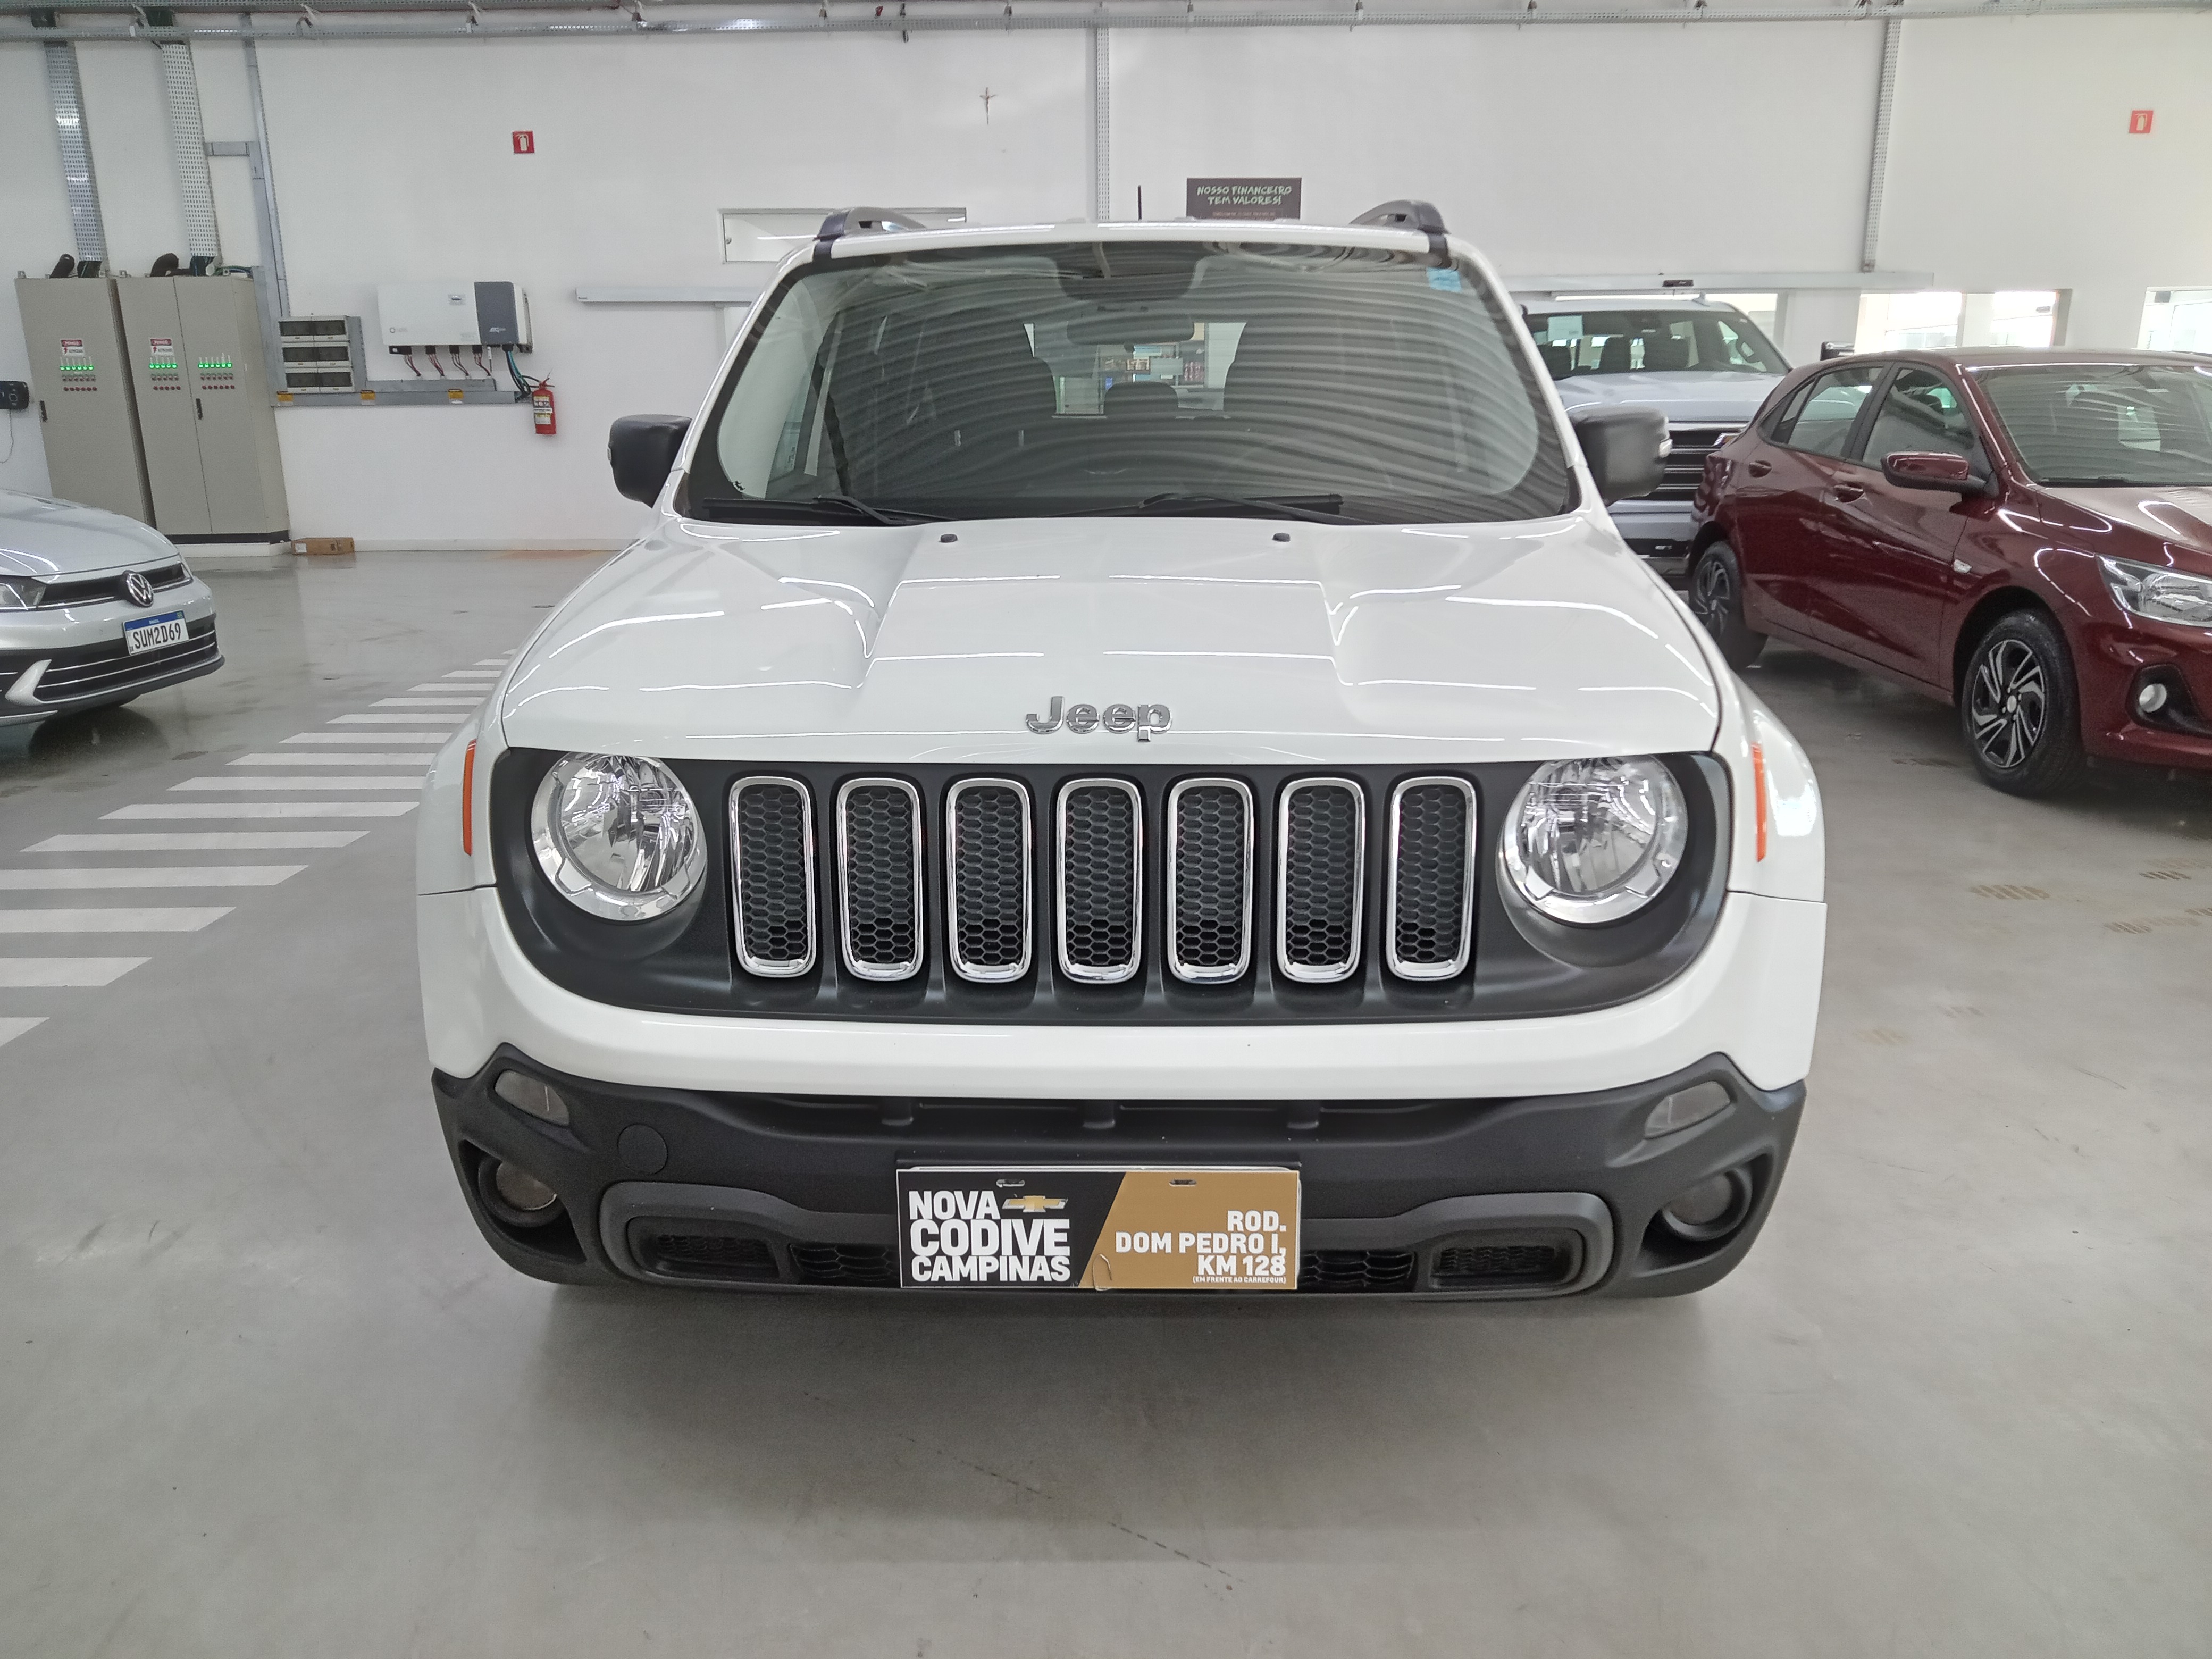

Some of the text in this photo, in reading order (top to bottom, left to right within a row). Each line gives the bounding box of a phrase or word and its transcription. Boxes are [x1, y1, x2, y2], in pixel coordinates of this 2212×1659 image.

[1197, 186, 1292, 196] NOSSO FINANCEIRO
[1208, 195, 1282, 205] TEM VALORES!
[133, 622, 181, 649] SUM2D69
[1026, 696, 1172, 742] Jeep
[908, 1190, 1001, 1220] NOVA
[1227, 1210, 1287, 1233] ROD.
[910, 1218, 1070, 1256] CODIVE
[1116, 1231, 1286, 1258] DOM PEDRO I,
[911, 1255, 1070, 1282] CAMPINAS
[1197, 1254, 1286, 1277] KM 128
